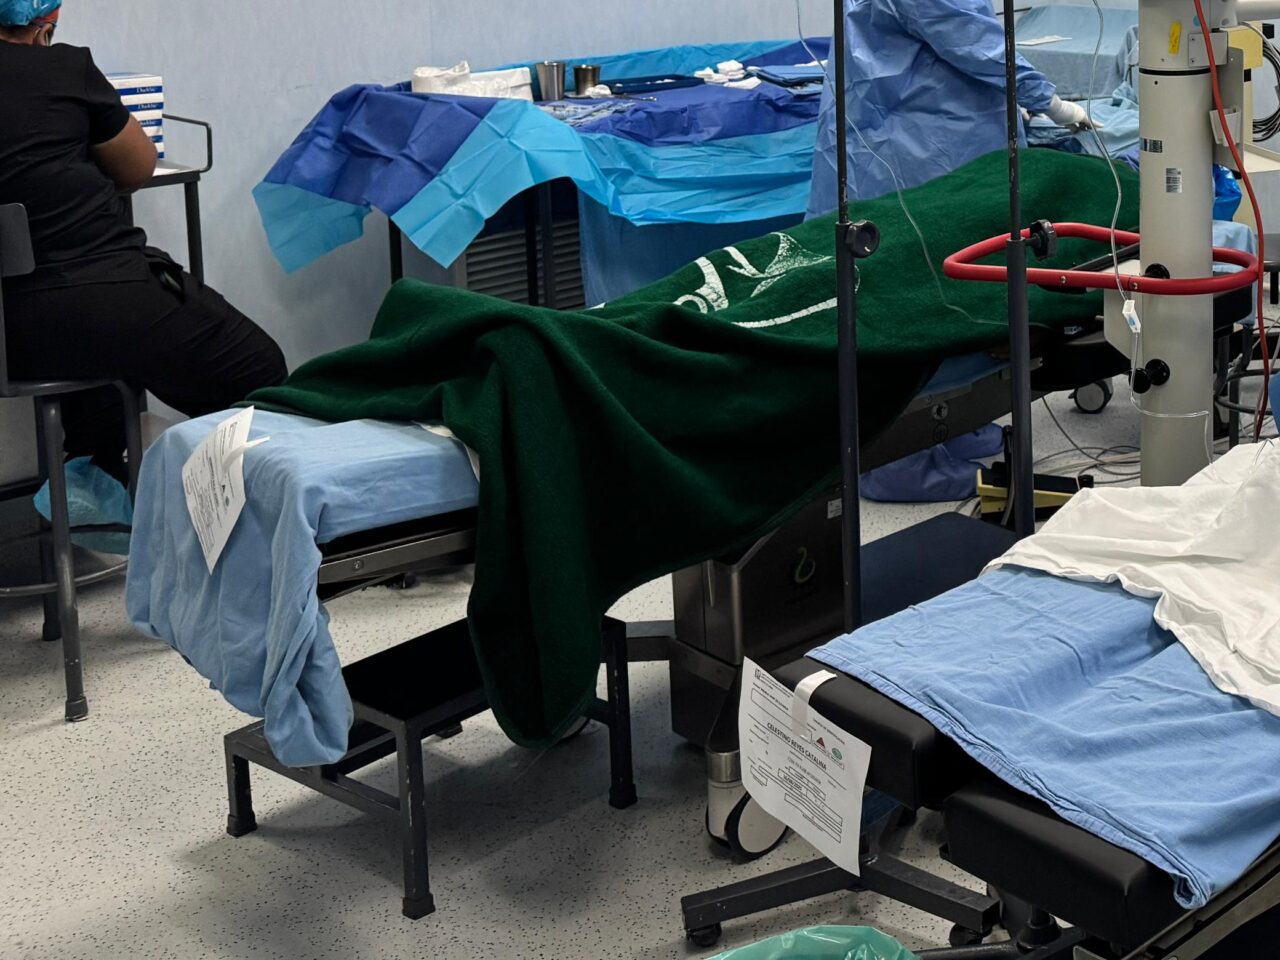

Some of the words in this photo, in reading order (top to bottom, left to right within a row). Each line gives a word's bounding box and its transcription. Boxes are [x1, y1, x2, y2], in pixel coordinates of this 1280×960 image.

[767, 722, 791, 744] CELESTINO
[790, 739, 805, 754] REYES
[804, 749, 827, 771] CATALINA
